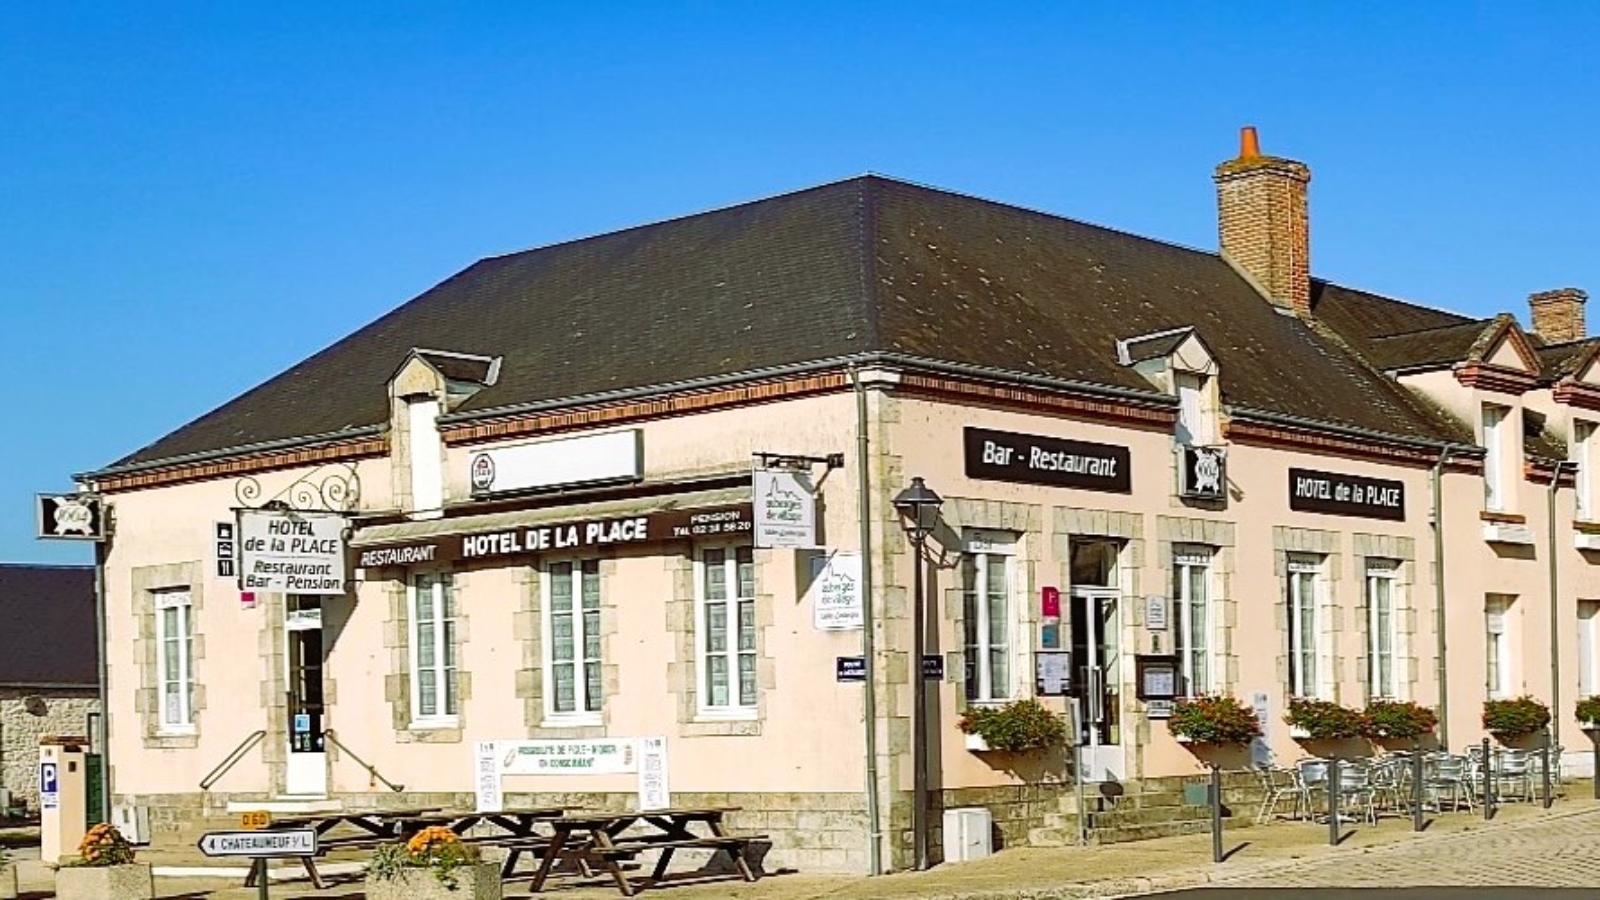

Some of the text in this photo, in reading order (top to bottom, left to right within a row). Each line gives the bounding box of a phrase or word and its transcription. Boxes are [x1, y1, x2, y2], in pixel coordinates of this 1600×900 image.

[982, 440, 1014, 465] Bar
[1029, 446, 1117, 477] Restaurant
[1296, 476, 1400, 507] HOTEL de la PLACE
[690, 510, 741, 524] PENSION
[268, 520, 315, 536] HOTEL
[737, 521, 751, 530] 20
[244, 537, 338, 554] de la PLACE
[463, 518, 648, 557] HOTEL DE LA PLACE
[360, 545, 438, 567] RESTAURANT
[253, 560, 332, 575] Restaurant
[246, 574, 272, 588] Bar
[286, 575, 340, 589] Pension
[208, 838, 215, 850] 4
[220, 836, 291, 850] CHATEAUNEUF
